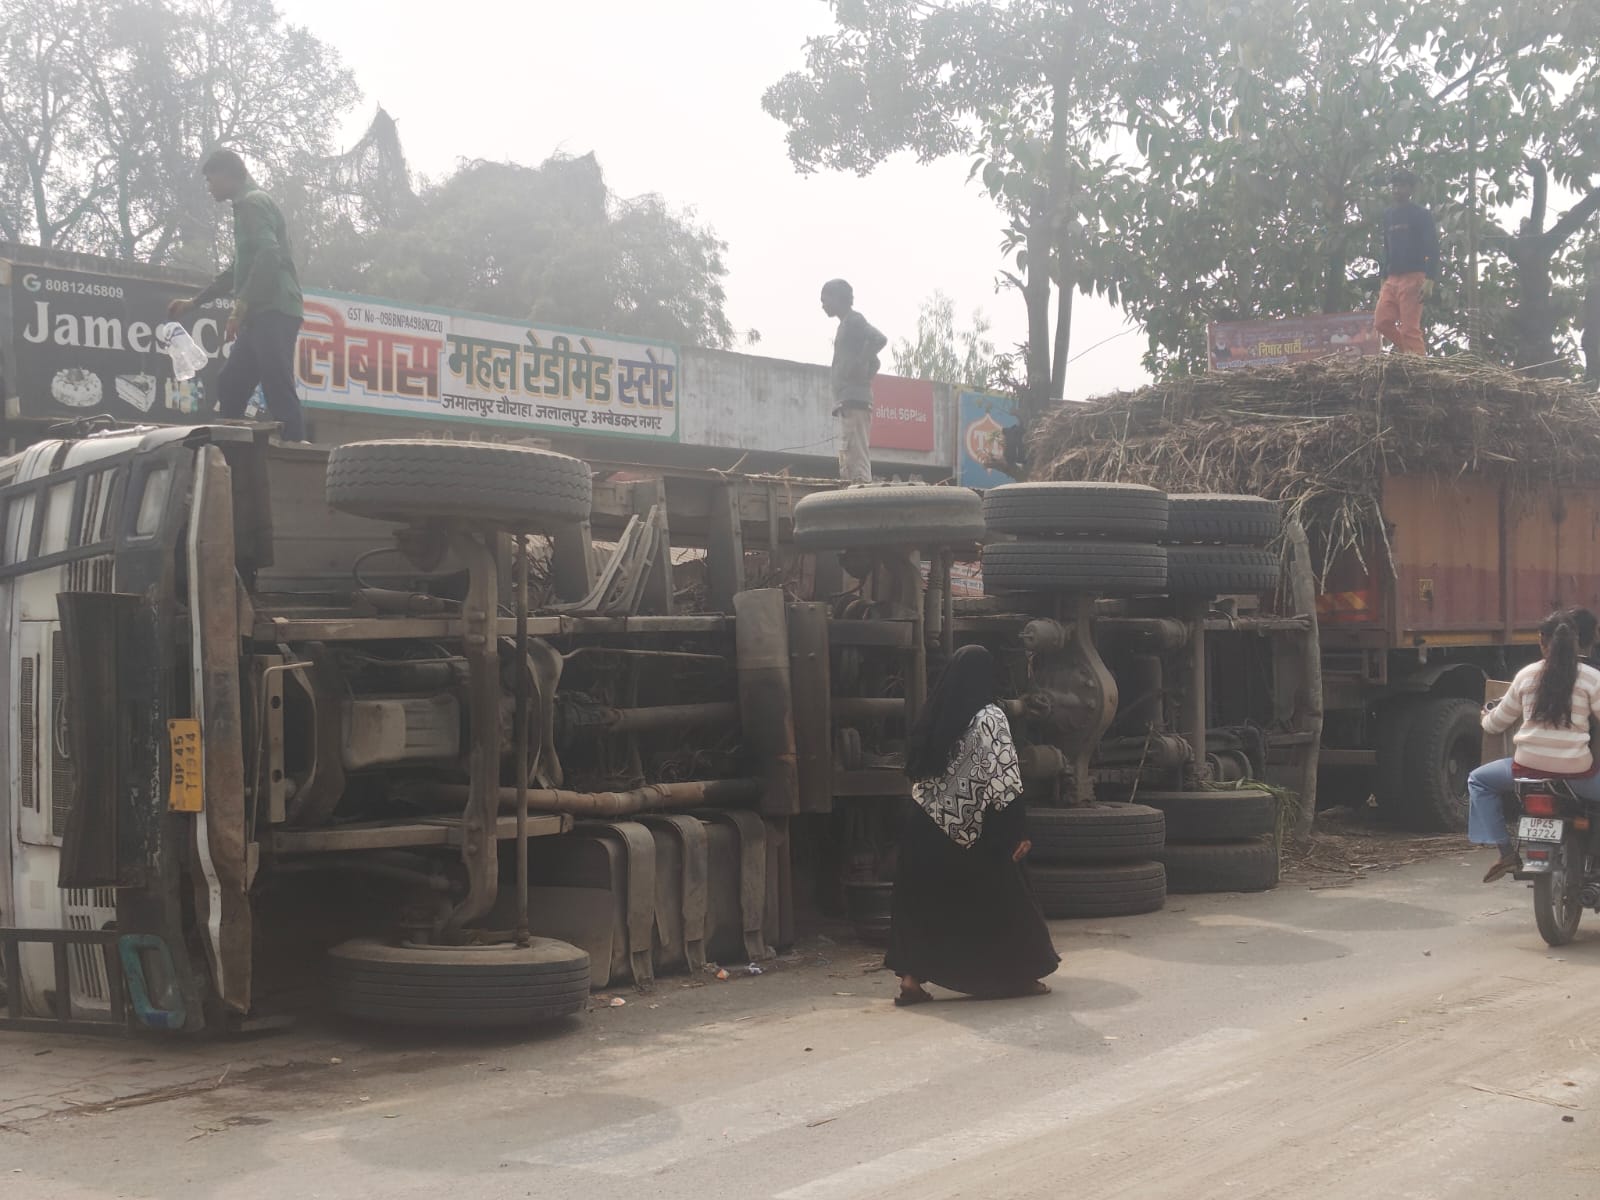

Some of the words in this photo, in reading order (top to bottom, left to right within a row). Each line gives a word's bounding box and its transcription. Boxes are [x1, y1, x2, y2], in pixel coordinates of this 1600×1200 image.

[45, 278, 124, 299] 8081245809
[347, 307, 362, 321] GST
[446, 333, 520, 391] महल
[523, 330, 614, 401] रेडीमेड
[617, 347, 676, 407] स्टोर
[442, 393, 495, 417] जमालपुर
[639, 415, 663, 430] नगर
[875, 403, 897, 420] airtel
[174, 735, 184, 757] 45
[175, 763, 185, 785] UP
